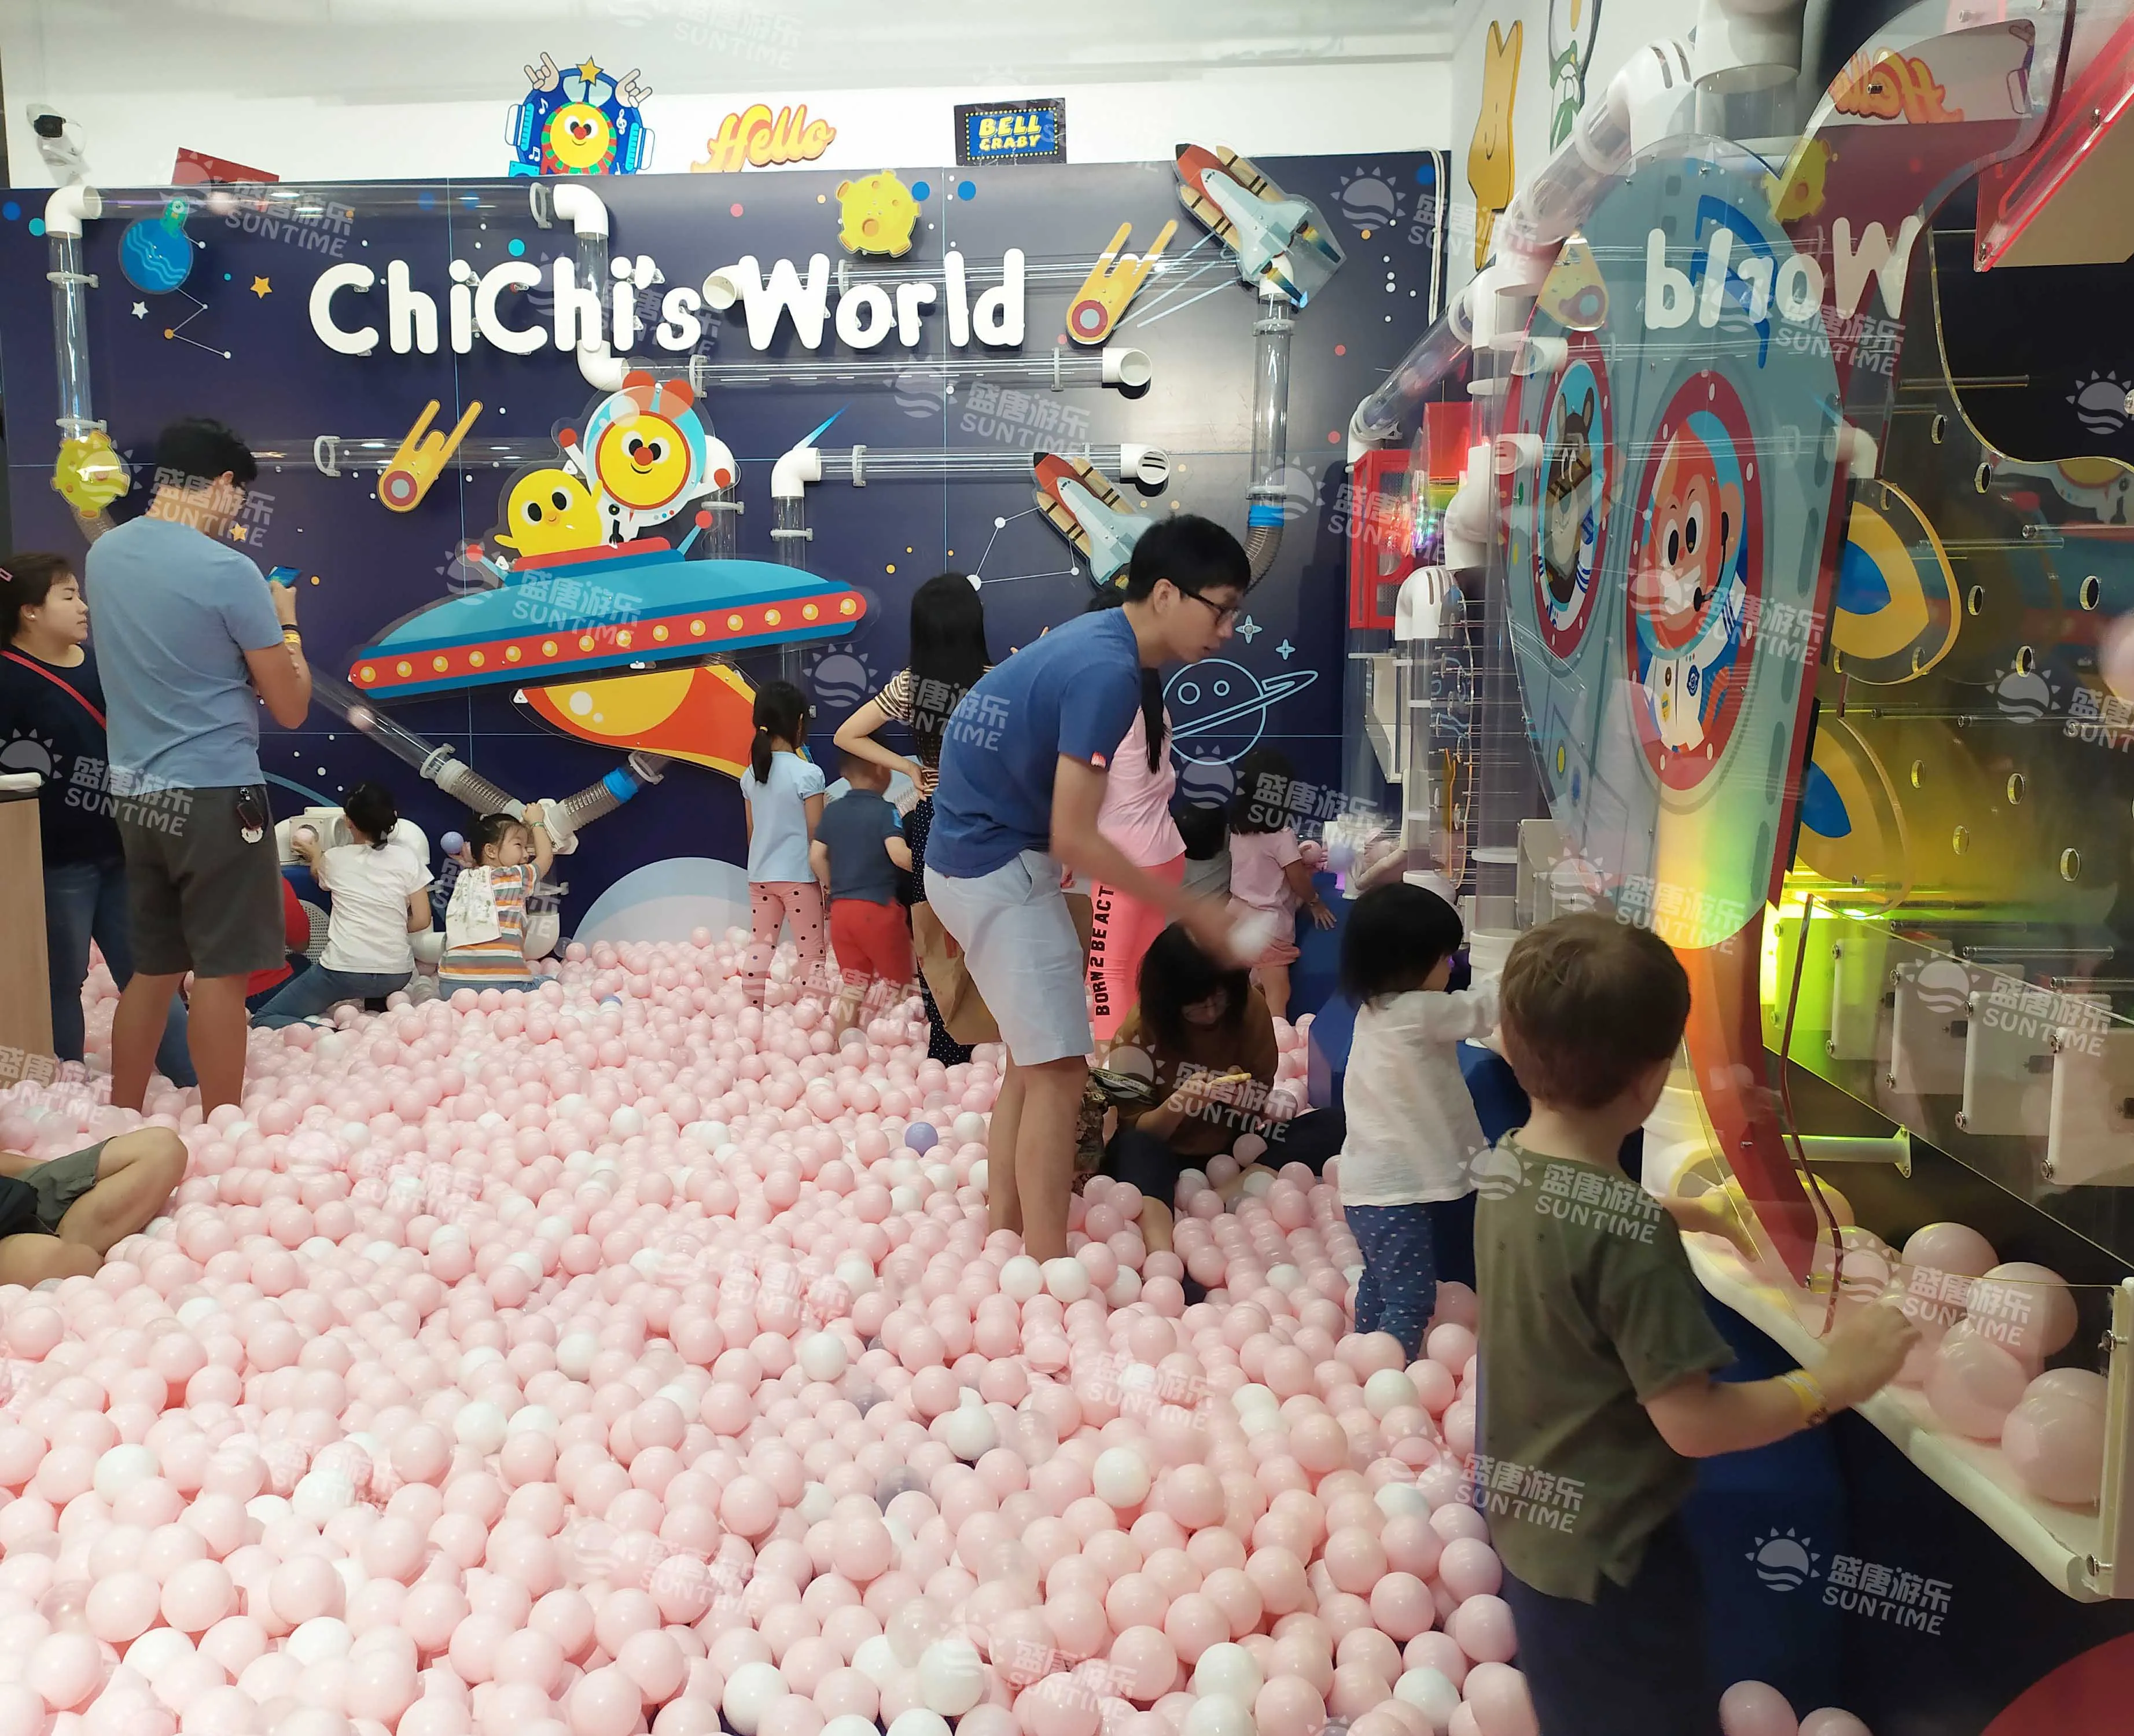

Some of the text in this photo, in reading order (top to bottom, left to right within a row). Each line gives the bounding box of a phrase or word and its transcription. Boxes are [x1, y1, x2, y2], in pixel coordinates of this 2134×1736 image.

[690, 104, 837, 172] Hello
[979, 115, 1042, 138] BELL
[310, 255, 702, 355] ChiChi's
[737, 248, 1025, 351] World
[1090, 885, 1114, 1016] BORN 2 BE ACT
